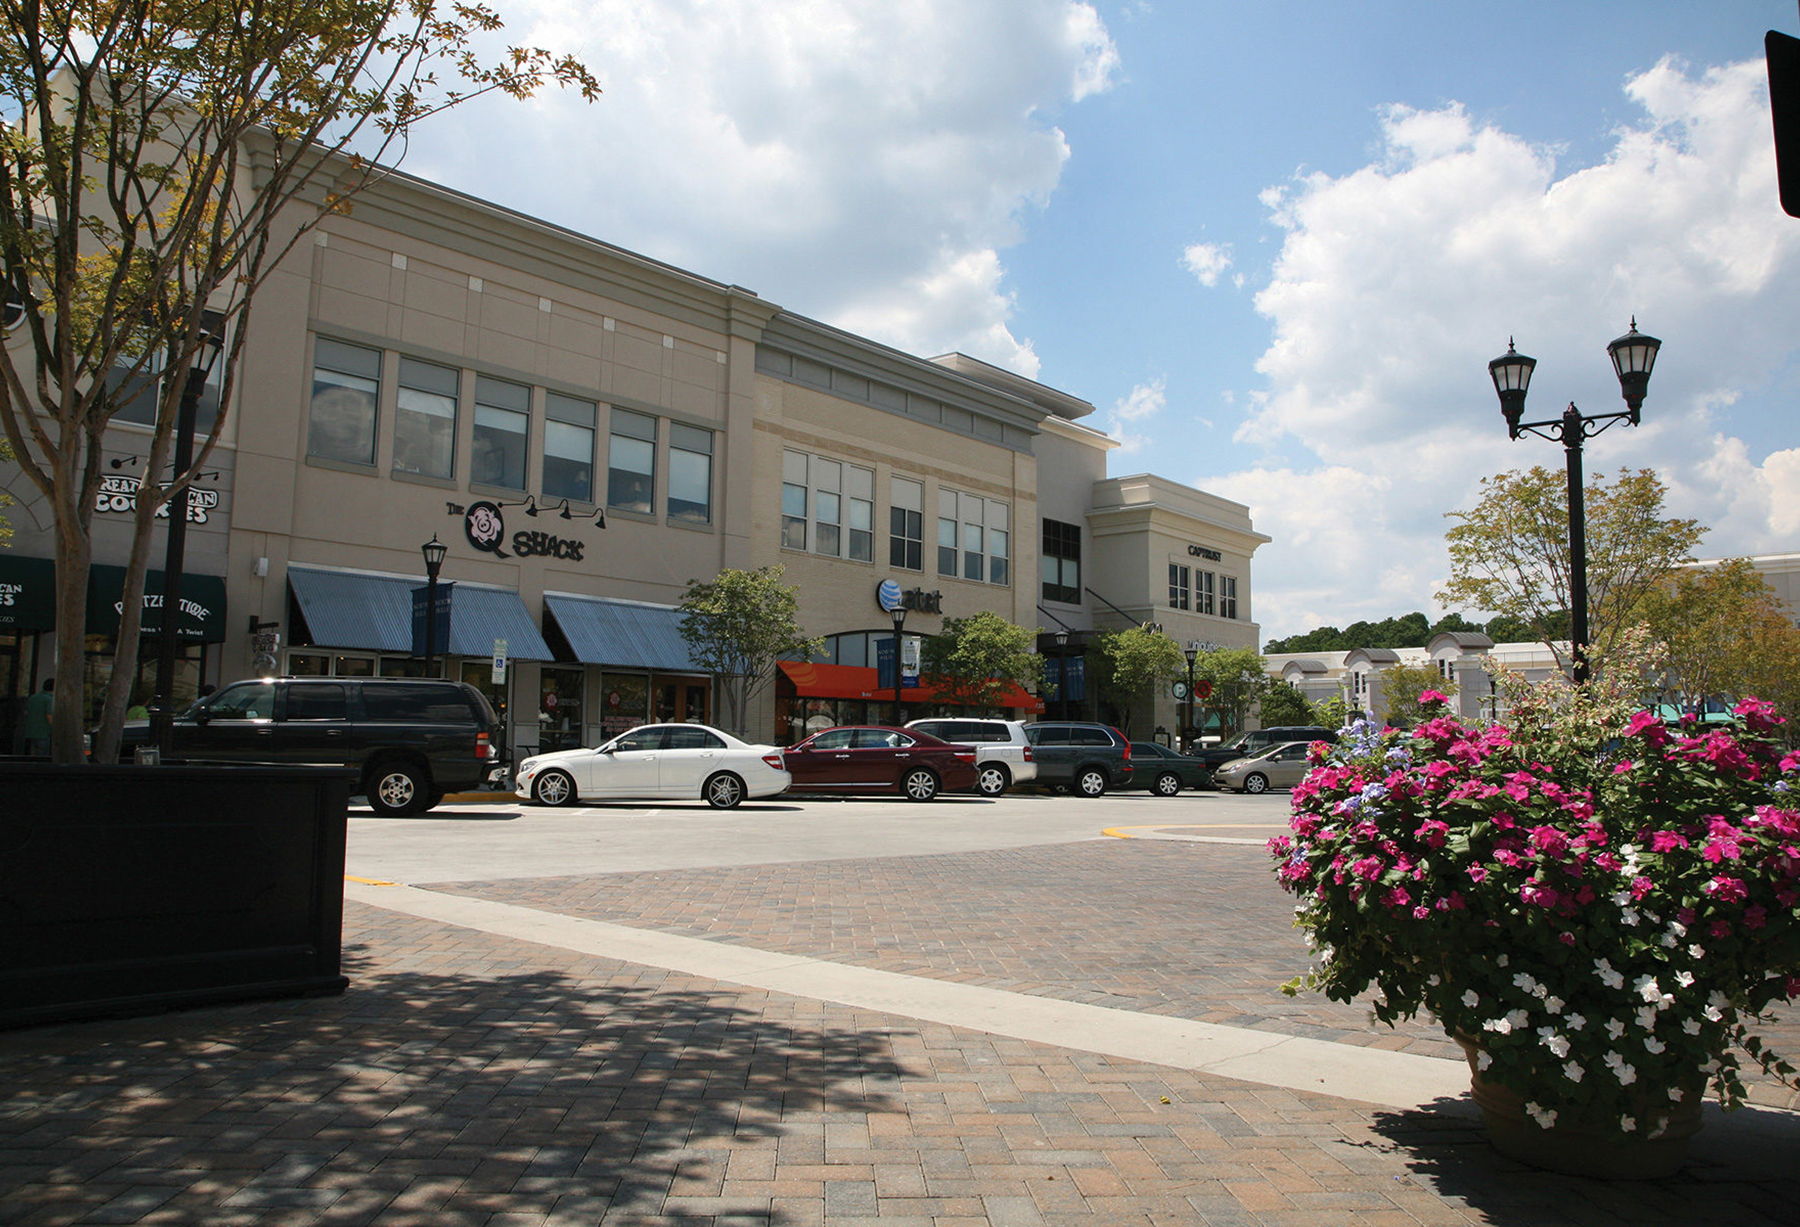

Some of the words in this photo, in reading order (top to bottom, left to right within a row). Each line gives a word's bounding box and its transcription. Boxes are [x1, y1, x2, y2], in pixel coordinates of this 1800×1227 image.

[100, 477, 140, 493] REAT
[512, 530, 585, 562] SHACK
[1176, 684, 1184, 696] P
